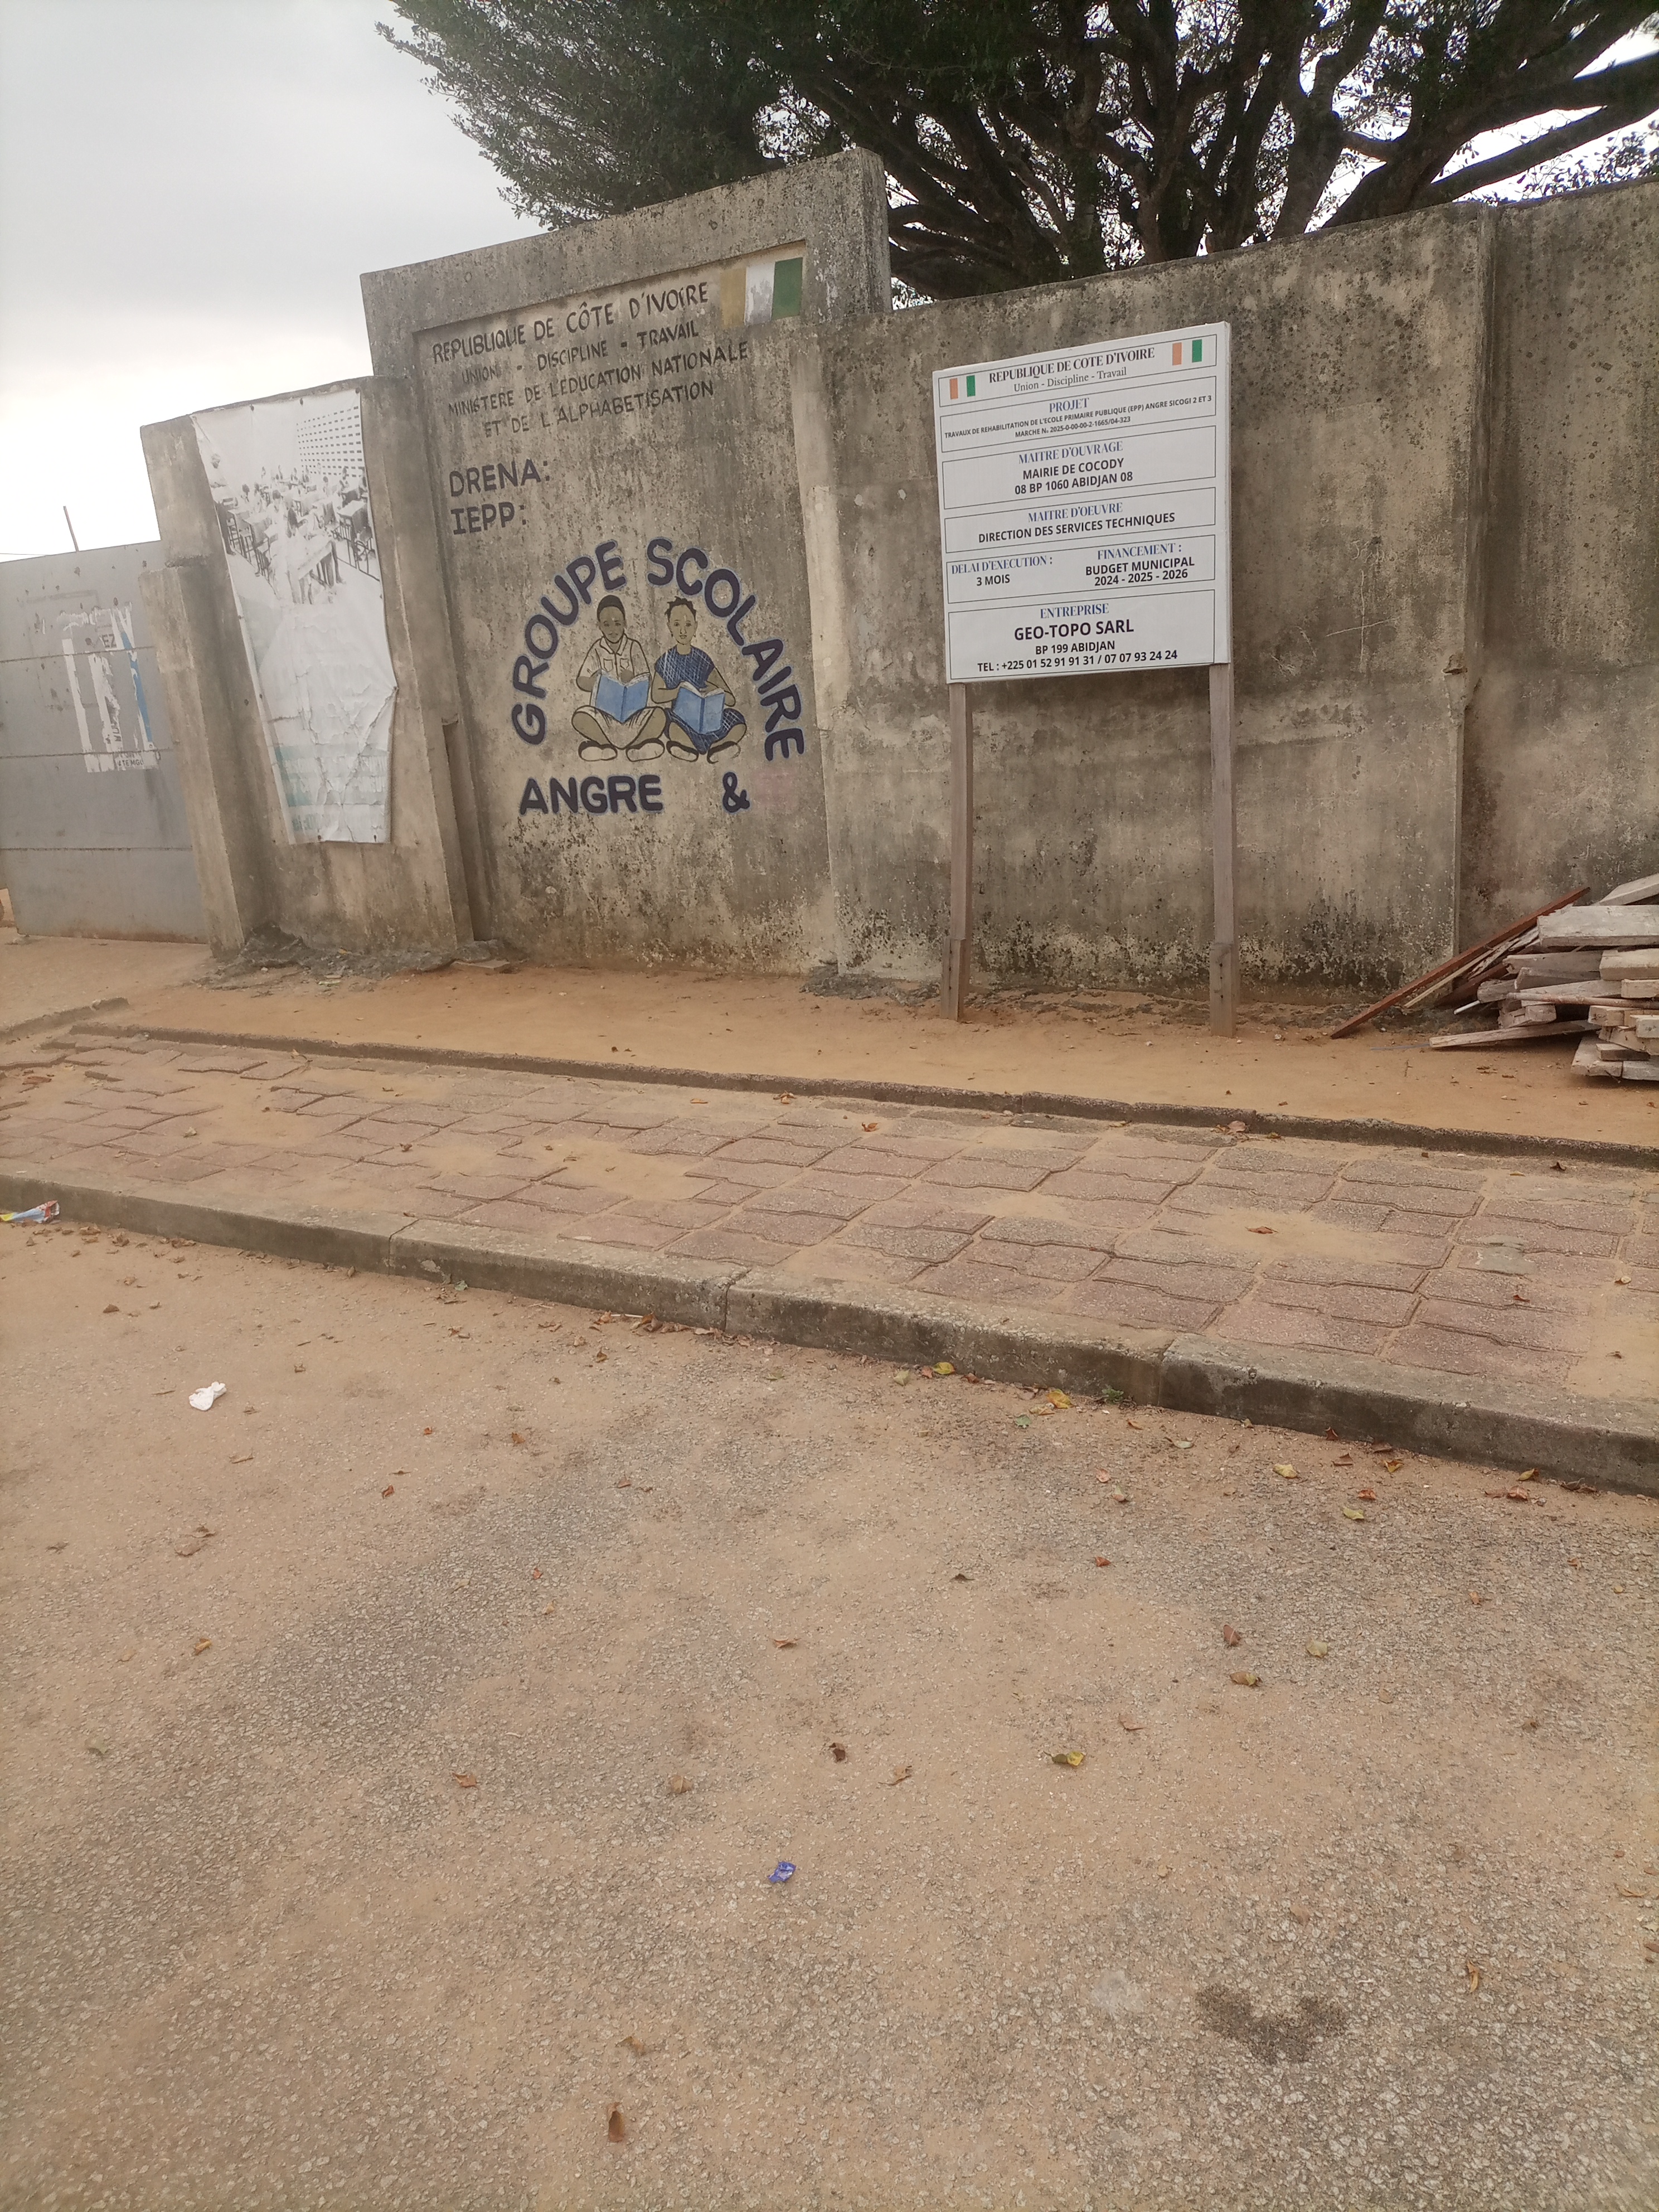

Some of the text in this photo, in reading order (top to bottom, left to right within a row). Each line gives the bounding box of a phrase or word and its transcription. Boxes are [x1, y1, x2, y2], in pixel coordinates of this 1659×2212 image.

[432, 282, 709, 365] REPUBLIQUE DE CÔTE D'IVOIRE
[462, 365, 499, 385] UNION
[537, 340, 609, 371] DISCIPLINE
[636, 320, 699, 350] TRAVAIL
[989, 347, 1155, 383] REPUBLIQUE DE COTE D'IVOIRE
[448, 390, 515, 417] MINISTERE
[524, 385, 542, 404] DE
[651, 341, 749, 378] NATIONALE
[1013, 382, 1039, 392] Union
[1047, 374, 1089, 387] Discipline
[1097, 367, 1127, 380] Travail
[1049, 397, 1090, 413] PROJET
[484, 420, 502, 438] ET
[511, 415, 530, 434] DE
[944, 429, 971, 439] TRAVAUX
[981, 420, 1029, 433] REHABILITATION
[1040, 415, 1063, 424] L'ECOLE
[1064, 411, 1094, 422] PRIMAIRE
[1095, 407, 1127, 416] PUBLIQUE
[1128, 404, 1144, 414] (EPP)
[1145, 401, 1168, 410] ANGRE
[1169, 397, 1191, 407] SICOGI
[1015, 428, 1040, 438] MARCHE
[1018, 441, 1123, 464] MAITRE D'OUVRAGE
[1023, 458, 1124, 480] MAIRIE DE COCODY
[1015, 471, 1133, 494] 08 BP 1060 ABIDJAN 08
[1028, 502, 1123, 523] MAITRE D'OEUVRE
[978, 512, 1175, 543] DIRECTION DES SERVICES TECHNIQUES
[1097, 543, 1176, 560] FINANCEMENT
[951, 562, 980, 575] DELAI
[982, 555, 1047, 571] D'EXECUTION
[1085, 556, 1195, 576] BUDGET MUNICIPAL
[976, 574, 1010, 586] 3 MOIS
[1094, 575, 1119, 586] 2024
[1128, 572, 1153, 583] 2025
[1162, 568, 1188, 580] 2026
[1040, 603, 1109, 619] ENTREPRISE
[1014, 619, 1134, 641] GEO-TOPO SARL
[512, 537, 805, 762] GROUPE SCOLAIRE
[1035, 641, 1115, 655] BP 199 ABIDJAN
[977, 662, 994, 672] TEL
[1001, 660, 1024, 670] +225
[1026, 659, 1037, 668] 01
[1040, 658, 1052, 668] 52
[1054, 657, 1066, 667] 91
[1069, 656, 1080, 666] 91
[1083, 656, 1094, 665] 31
[1097, 654, 1102, 664] /
[1104, 654, 1117, 663] 07
[1119, 653, 1132, 662] 07
[1134, 652, 1147, 662] 93
[1149, 651, 1162, 661] 24
[1165, 649, 1178, 660] 24
[519, 774, 664, 815] ANGRE
